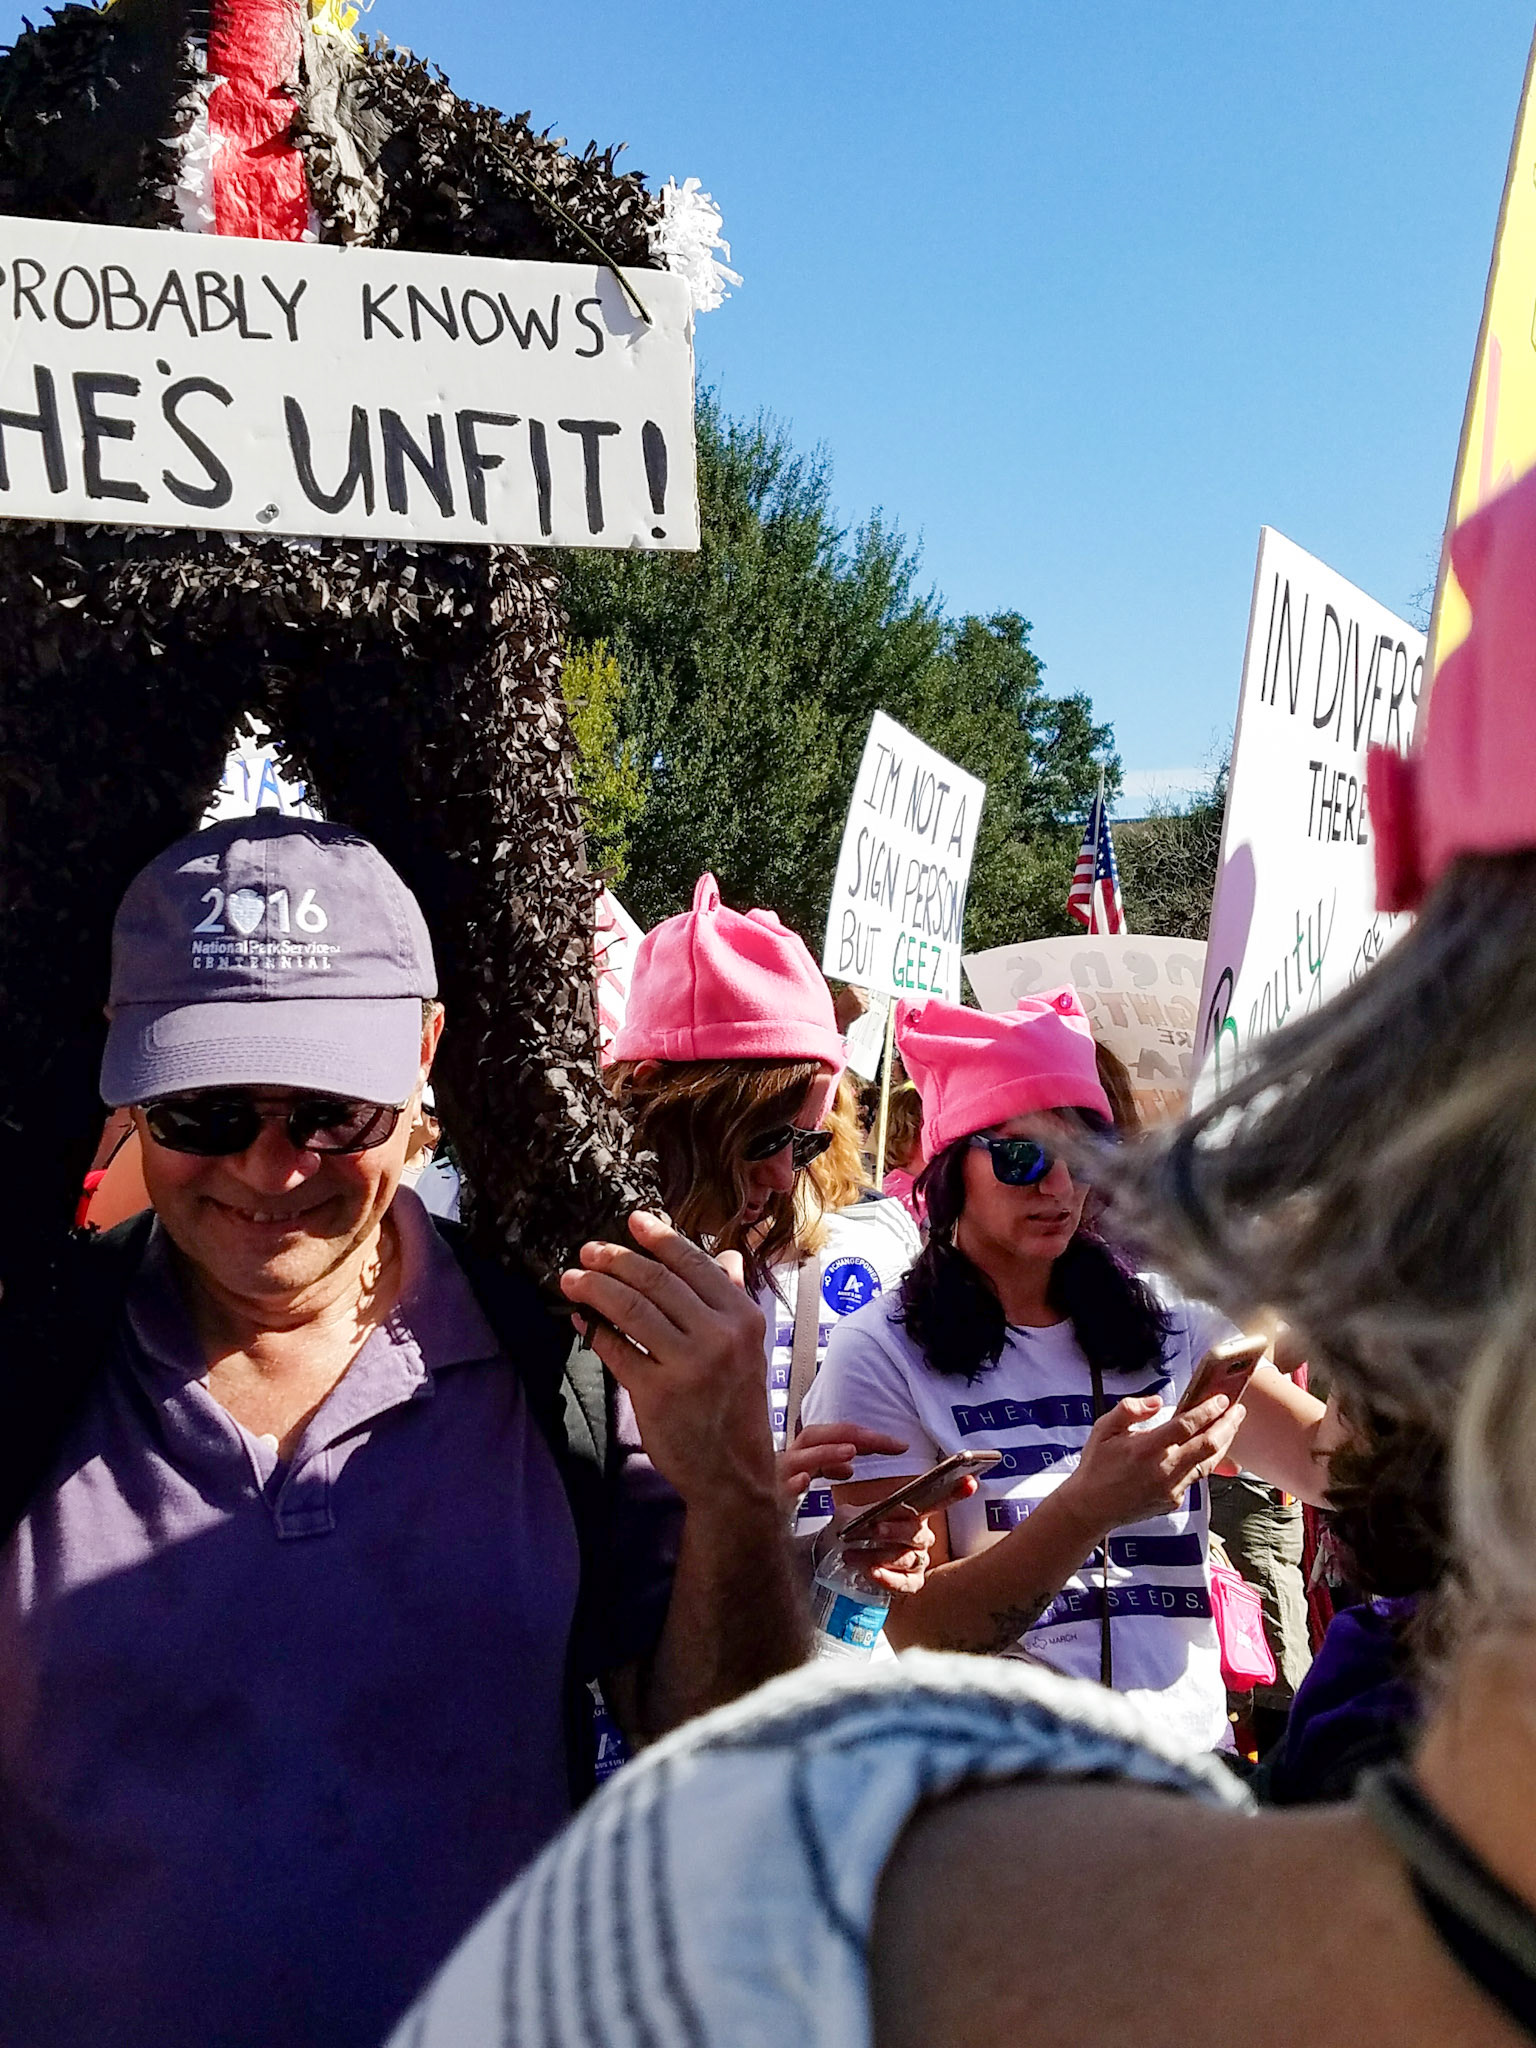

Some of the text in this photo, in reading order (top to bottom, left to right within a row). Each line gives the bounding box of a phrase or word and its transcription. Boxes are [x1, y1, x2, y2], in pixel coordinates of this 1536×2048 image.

[0, 258, 604, 357] ROBABLY KNOWS
[0, 359, 667, 539] HE'S UNFIT!
[1261, 572, 1309, 716] IN
[863, 743, 966, 858] I'M NOT A
[1308, 760, 1369, 845] THERE
[848, 826, 967, 944] SIGN PERSON
[192, 956, 331, 969] CENTENNIAL
[839, 909, 950, 1000] BUT GEEZ!
[957, 1404, 1033, 1426] THEY
[1106, 1590, 1204, 1611] SEEDS.
